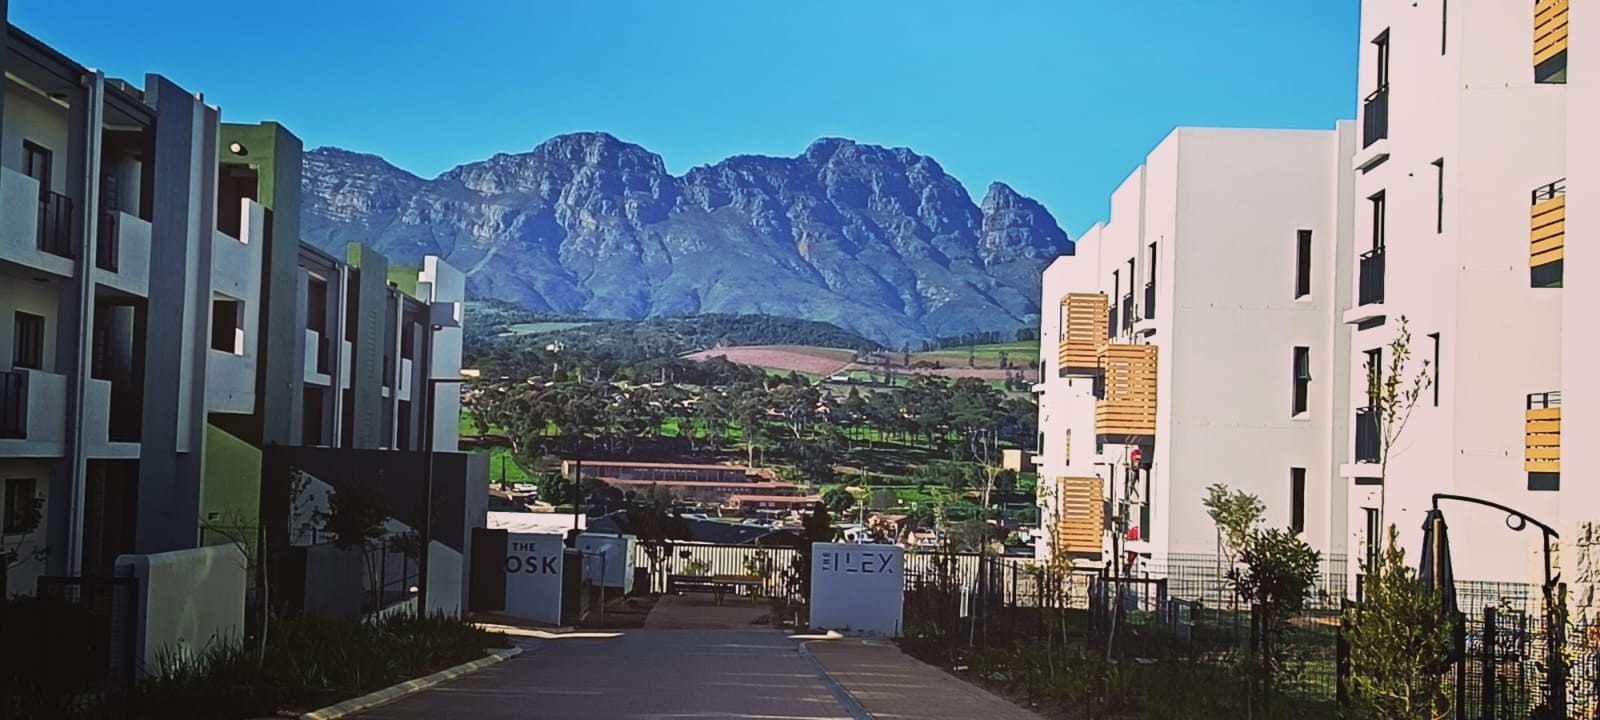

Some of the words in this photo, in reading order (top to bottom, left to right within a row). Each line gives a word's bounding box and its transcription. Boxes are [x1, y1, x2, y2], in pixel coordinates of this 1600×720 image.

[511, 542, 536, 552] THE
[506, 556, 558, 575] OSK
[822, 552, 831, 571] THE
[834, 552, 894, 574] ILEX
